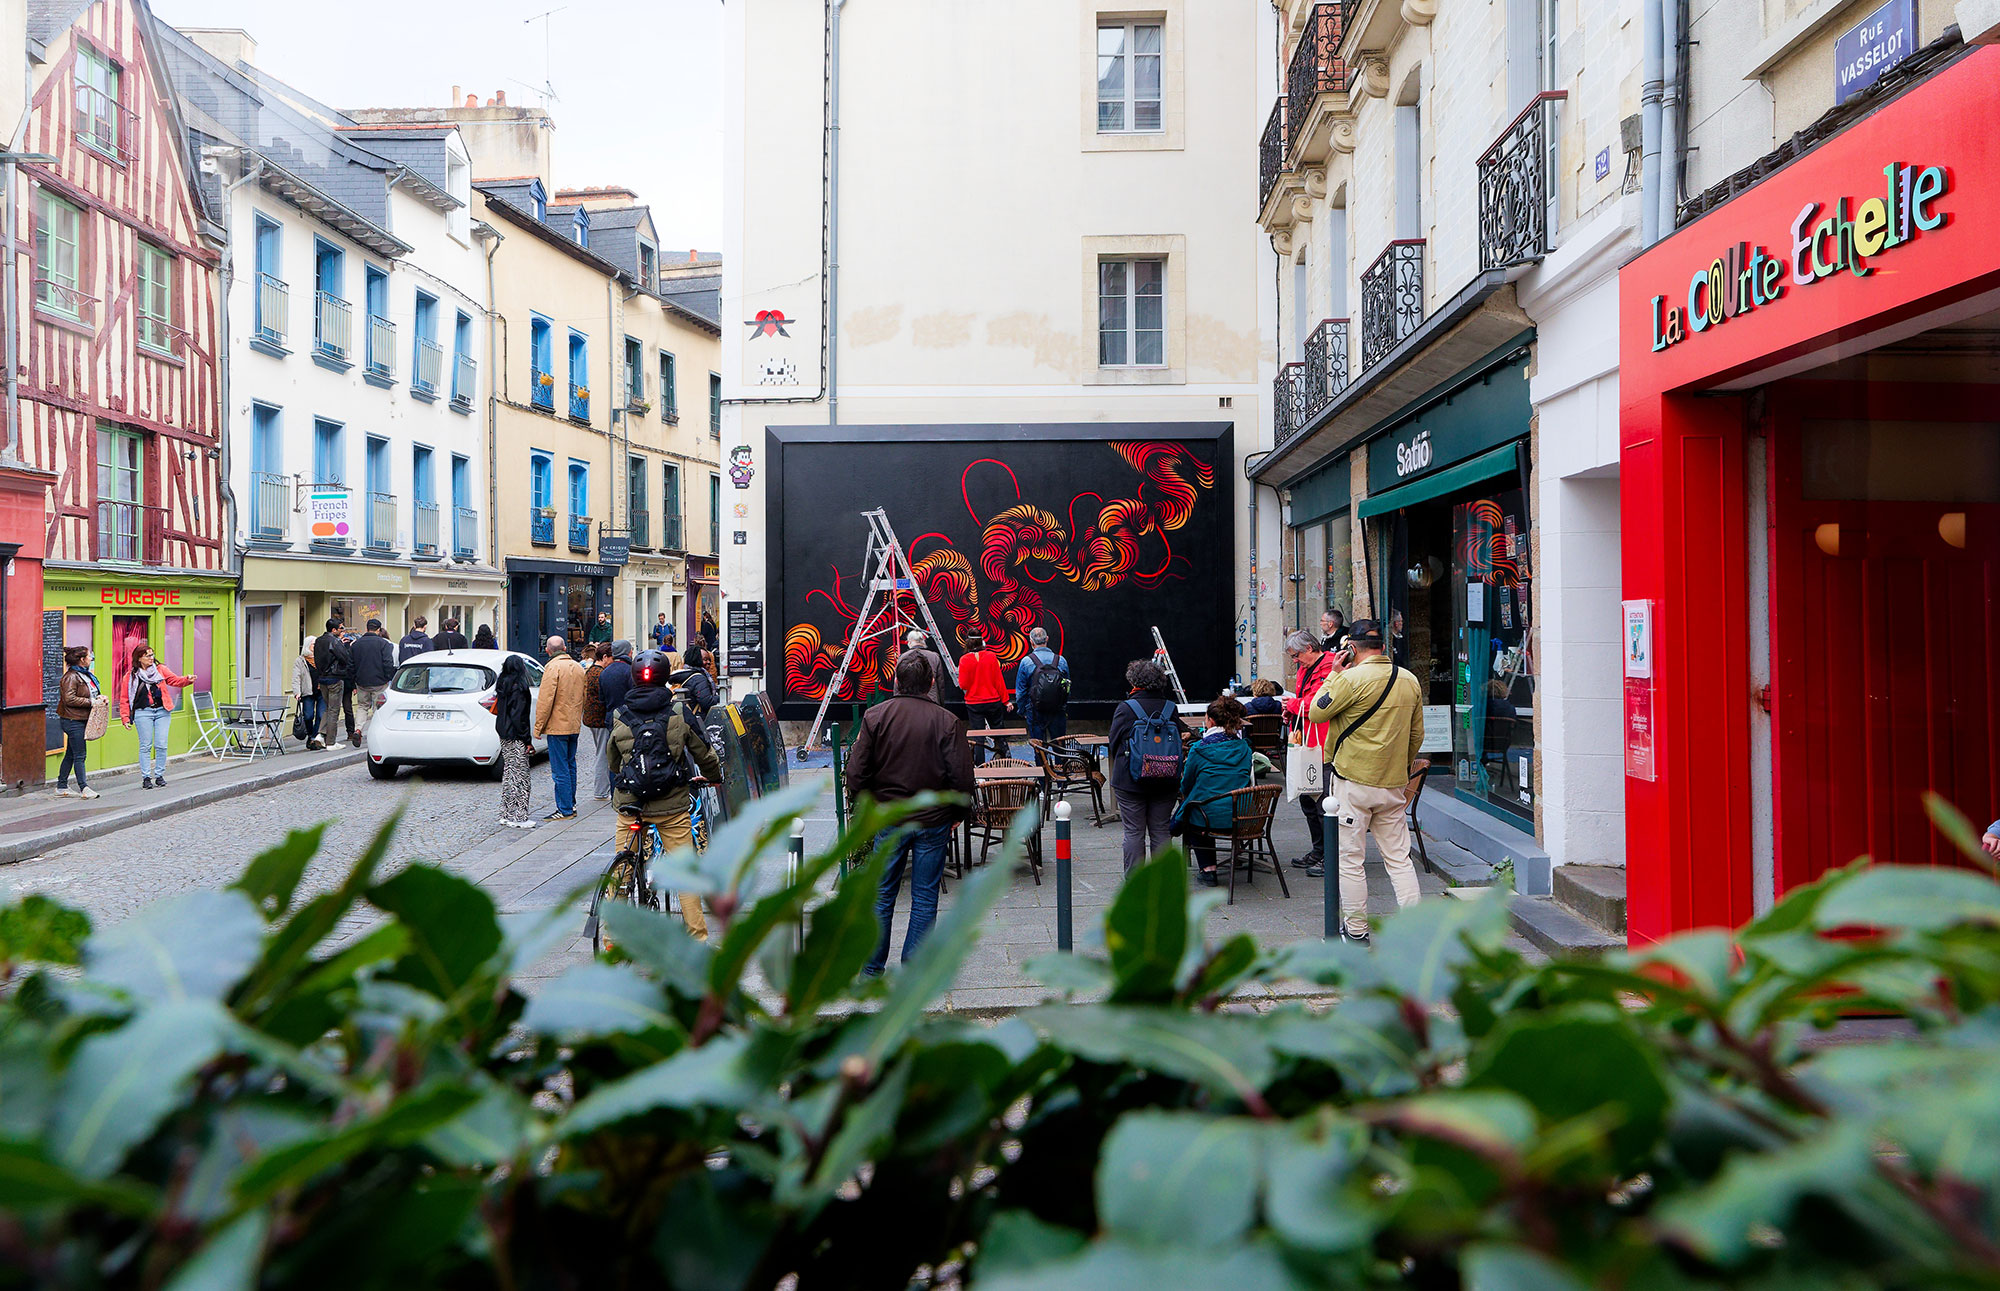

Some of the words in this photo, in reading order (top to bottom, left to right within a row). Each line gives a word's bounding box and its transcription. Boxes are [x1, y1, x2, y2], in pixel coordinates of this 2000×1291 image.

[1841, 28, 1903, 86] VASSELOT
[1597, 152, 1606, 176] 32
[1651, 295, 1685, 352] La
[312, 500, 348, 510] French
[314, 510, 347, 521] Fripes
[574, 565, 581, 573] LA
[583, 566, 605, 575] CRIQUE
